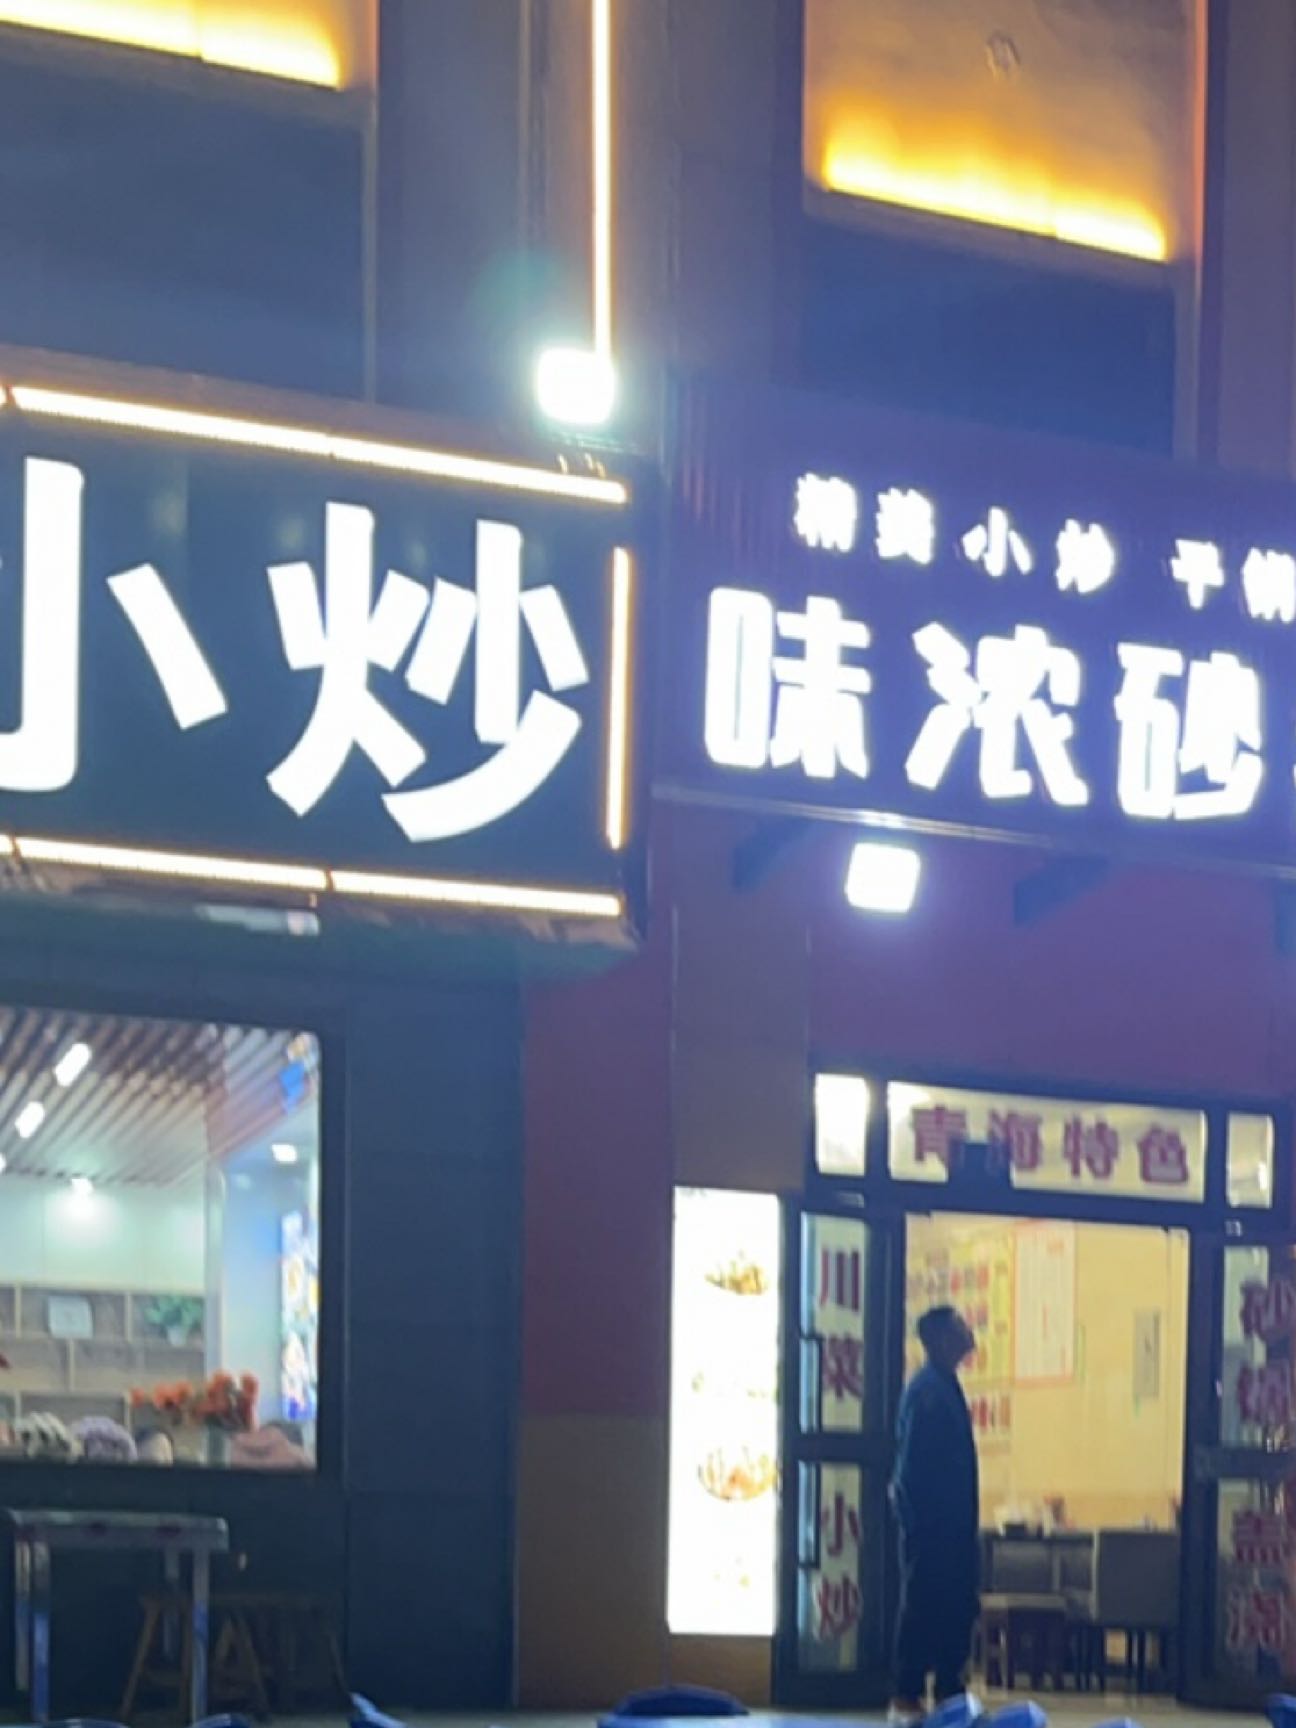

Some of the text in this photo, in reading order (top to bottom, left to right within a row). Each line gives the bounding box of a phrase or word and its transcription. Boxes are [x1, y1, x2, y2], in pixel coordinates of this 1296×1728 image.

[0, 456, 590, 843] 小炒
[910, 1104, 1190, 1186] 青海特色
